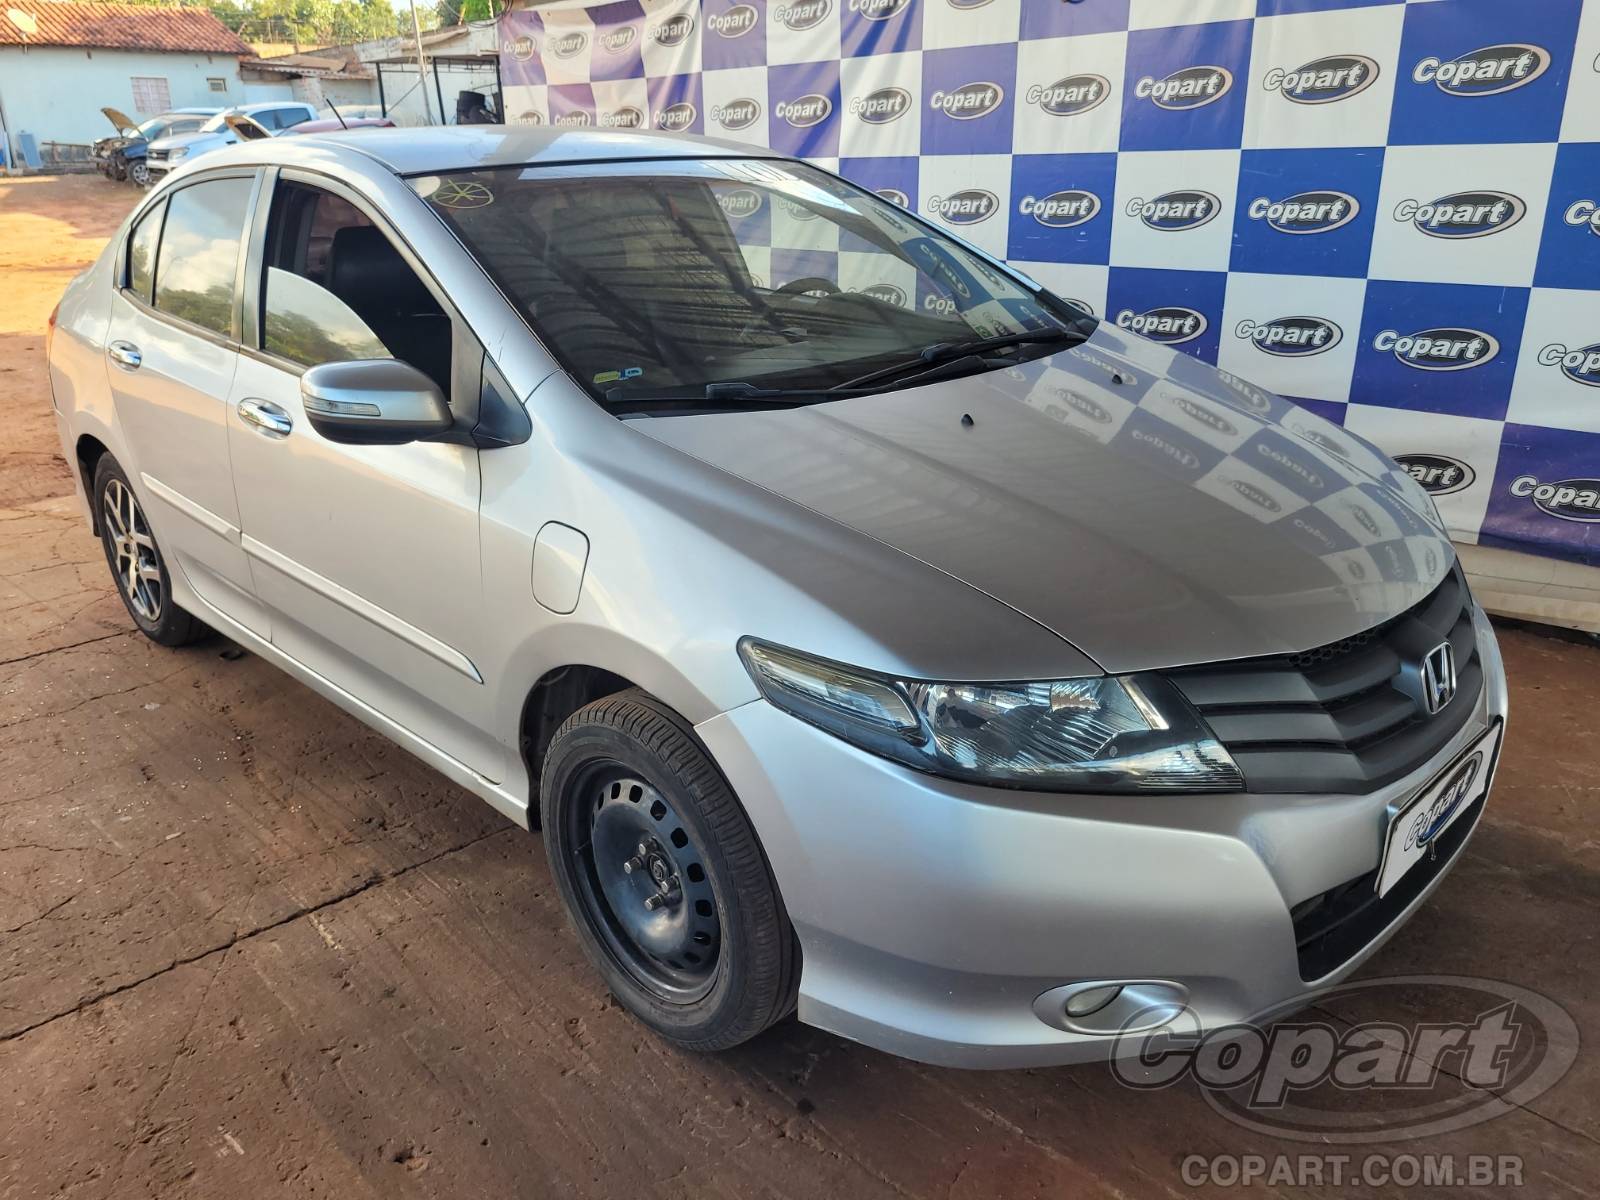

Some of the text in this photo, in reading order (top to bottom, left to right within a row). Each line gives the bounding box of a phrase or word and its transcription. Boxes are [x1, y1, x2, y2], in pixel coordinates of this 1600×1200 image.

[707, 10, 751, 31] Copart
[774, 2, 825, 25] Copart
[598, 29, 633, 49] Copart
[1263, 60, 1366, 95] Copart
[1411, 50, 1534, 88] Copart
[1026, 80, 1099, 107] Copart
[1134, 71, 1222, 102] Copart
[711, 103, 753, 121] Copart
[775, 101, 824, 121] Copart
[849, 93, 902, 116] Copart
[930, 88, 994, 115] Copart
[602, 110, 639, 127] Copart
[653, 108, 691, 127] Copart
[927, 195, 990, 217] Copart
[1019, 195, 1092, 220] Copart
[1125, 196, 1213, 222] Copart
[1248, 196, 1348, 226] Copart
[1393, 197, 1508, 230] Copart
[1116, 309, 1198, 335] Copart
[1235, 319, 1331, 348] Copart
[1374, 330, 1485, 361] Copart
[1404, 764, 1474, 852] Copart
